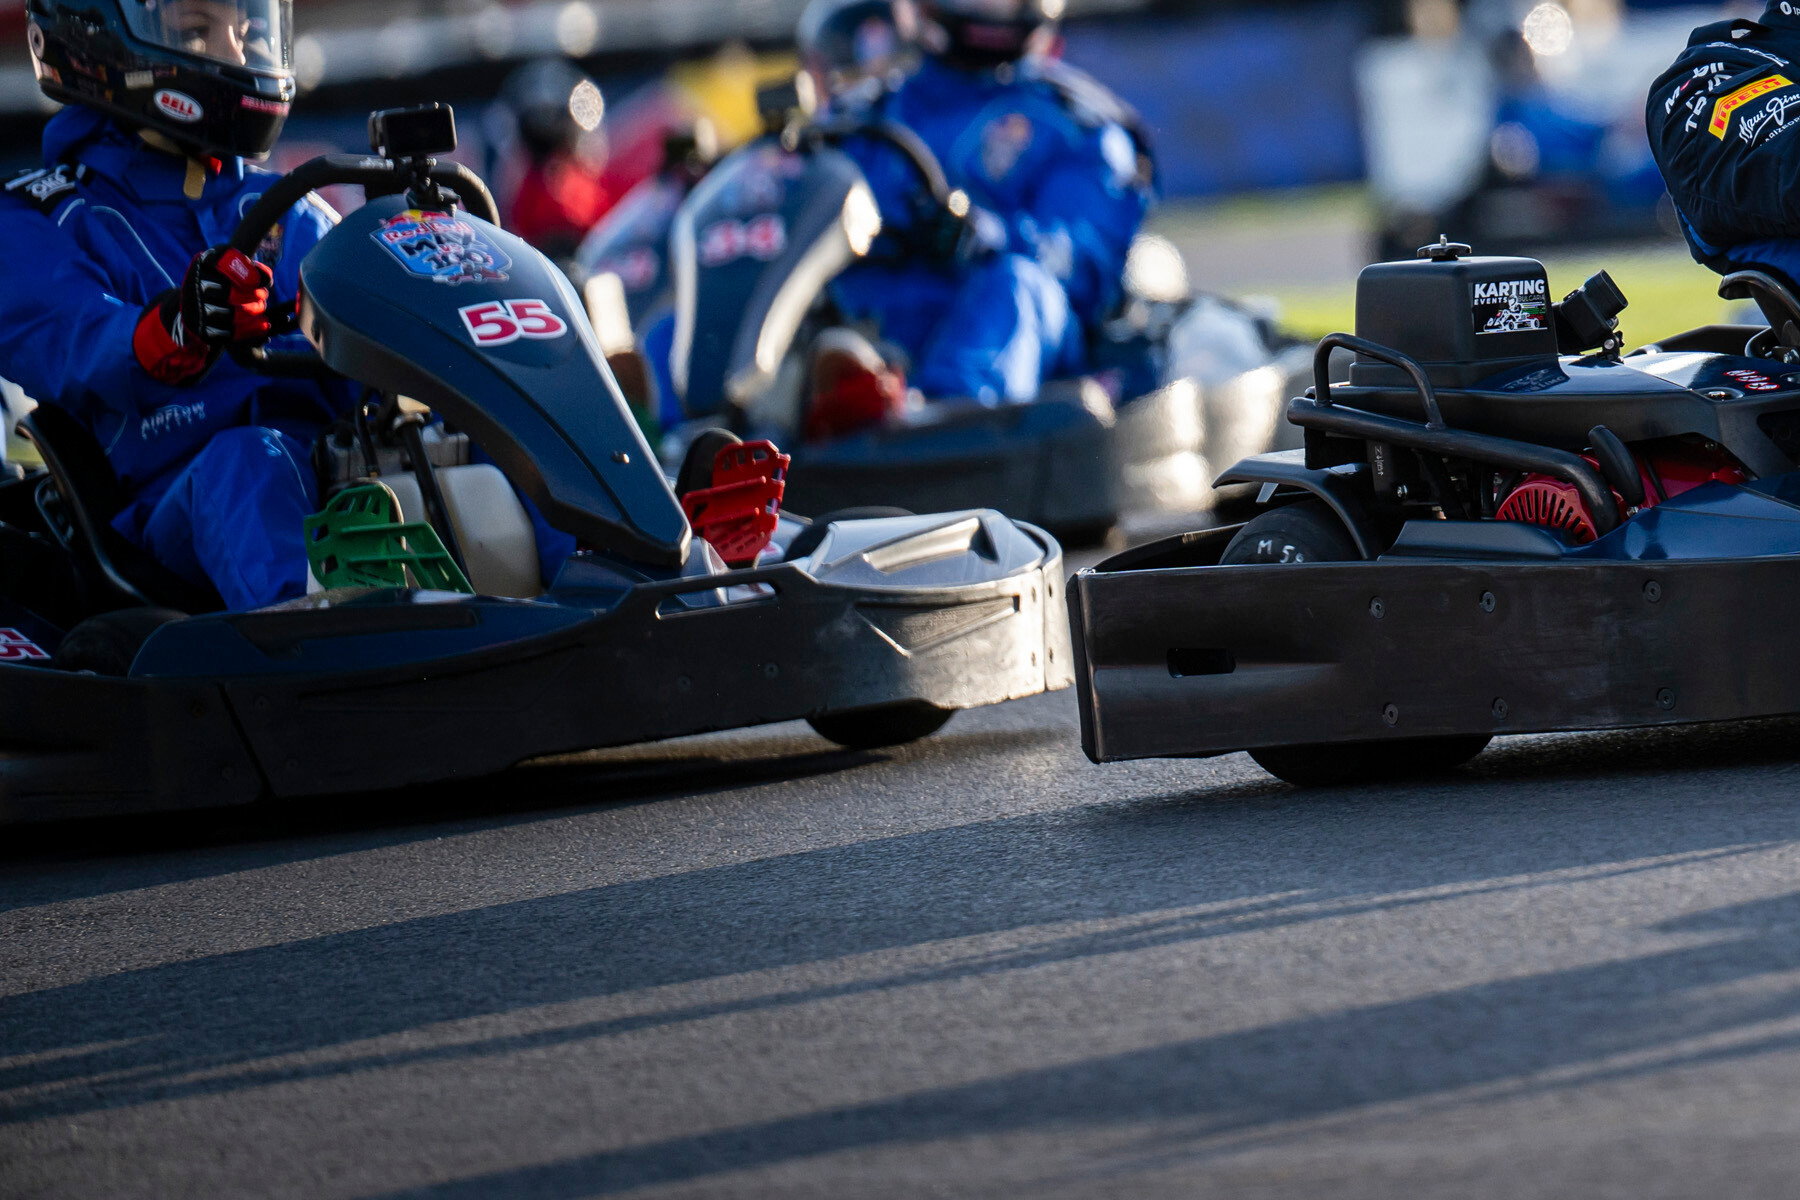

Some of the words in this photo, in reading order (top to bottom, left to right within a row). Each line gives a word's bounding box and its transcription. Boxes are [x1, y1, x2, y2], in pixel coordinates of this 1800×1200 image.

[160, 93, 196, 115] BELL
[1713, 77, 1784, 131] PIRELLI
[1474, 279, 1545, 298] KARTING
[1474, 296, 1508, 305] EVENTS
[458, 299, 568, 347] 55
